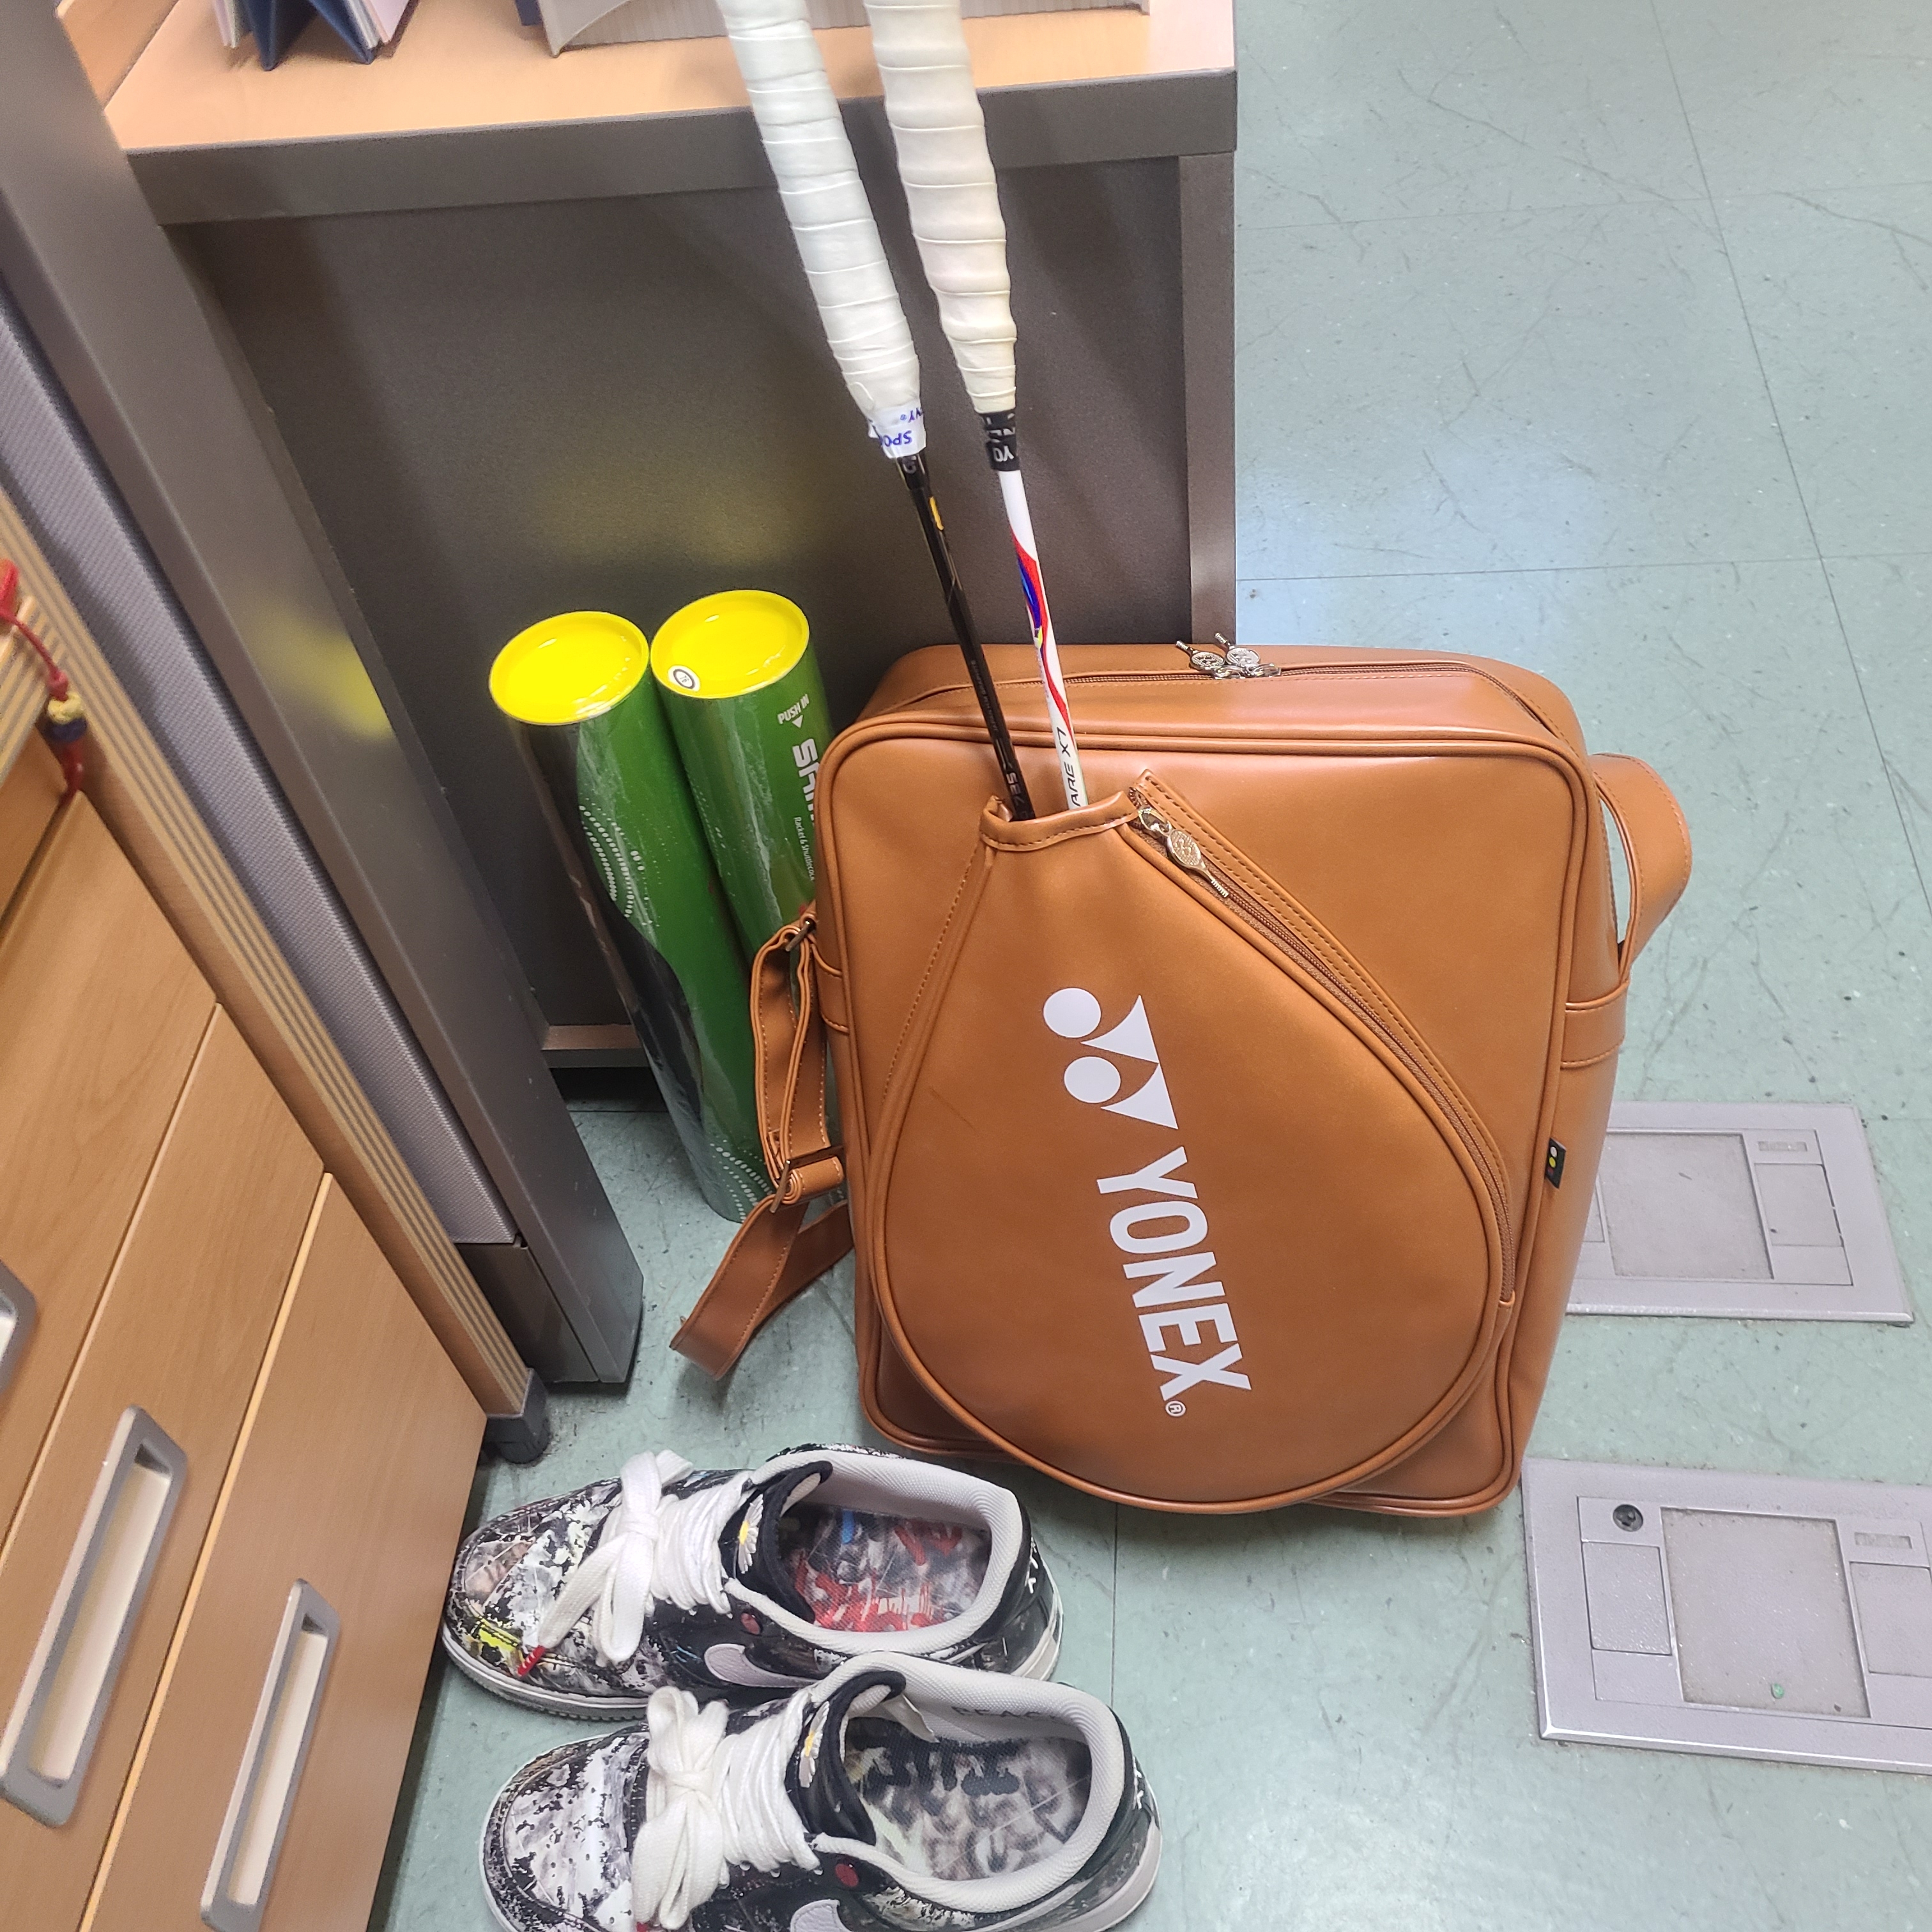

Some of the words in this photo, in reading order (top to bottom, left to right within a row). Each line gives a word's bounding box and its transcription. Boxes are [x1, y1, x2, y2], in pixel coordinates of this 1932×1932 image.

[778, 702, 801, 724] PUSH
[800, 694, 809, 709] IN
[1057, 726, 1070, 758] X7
[793, 816, 805, 838] Racket
